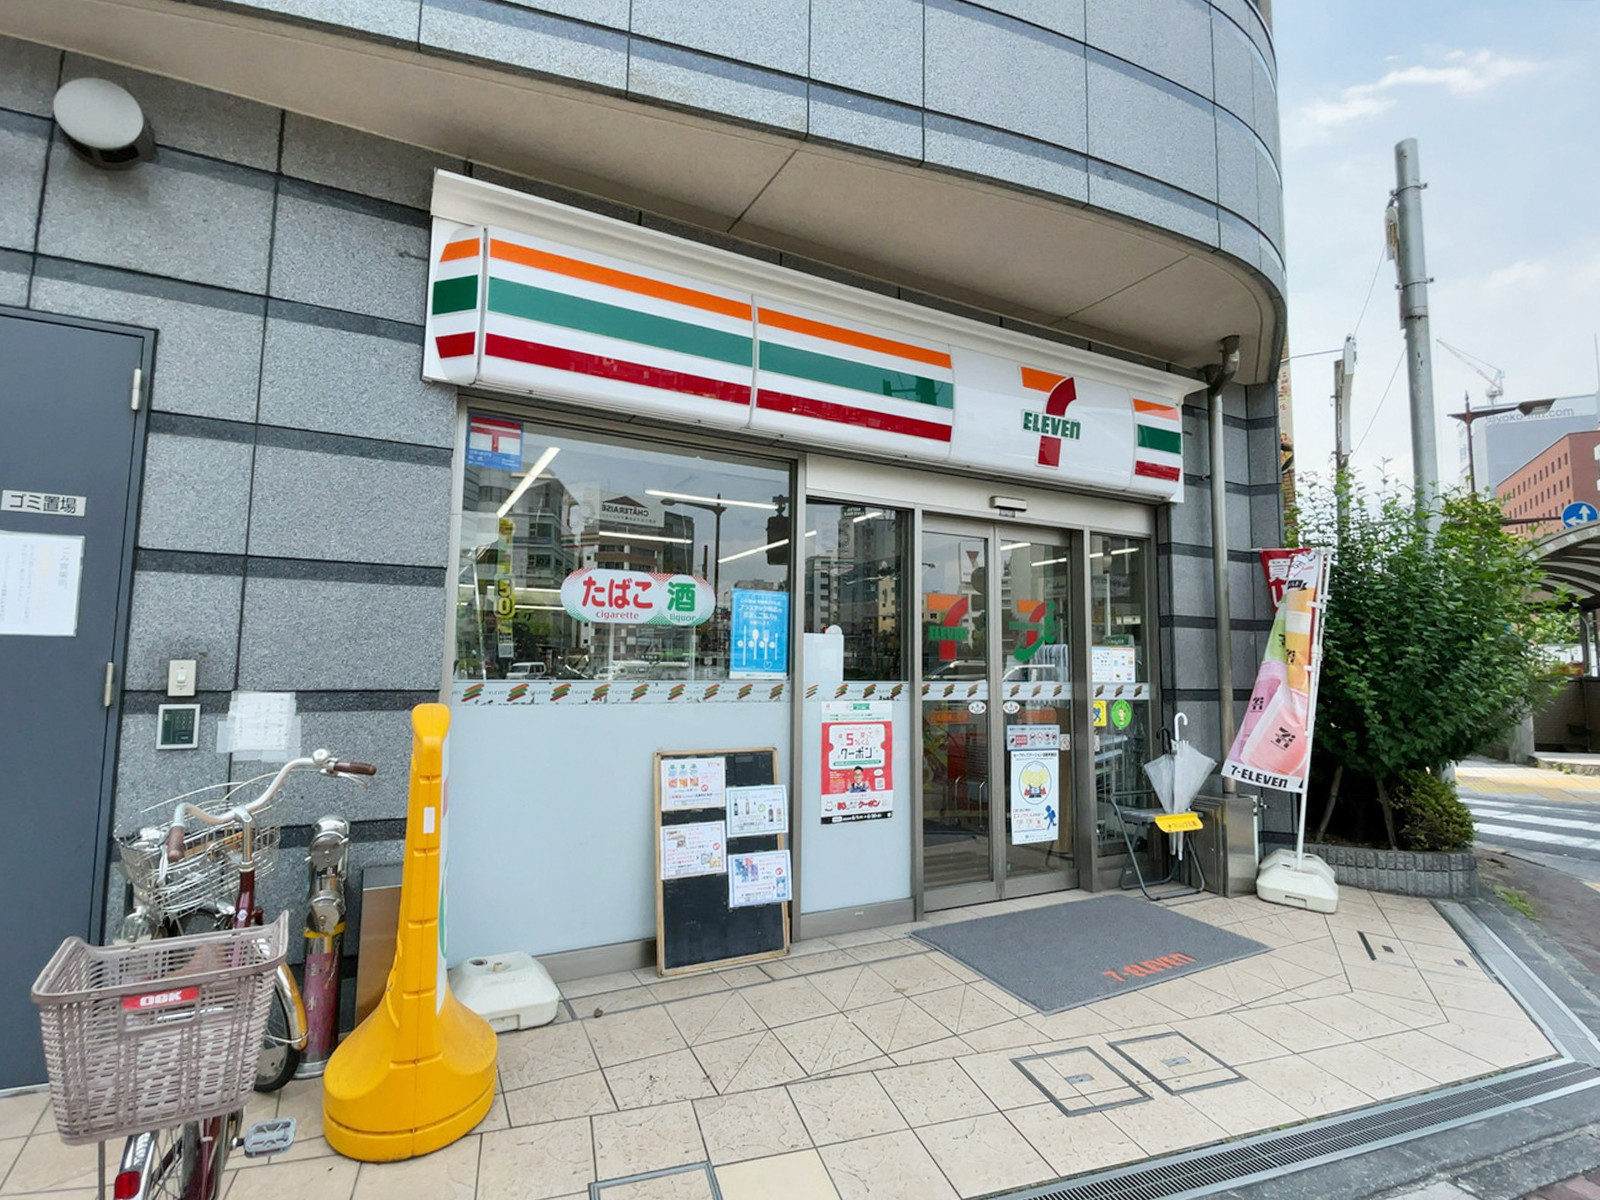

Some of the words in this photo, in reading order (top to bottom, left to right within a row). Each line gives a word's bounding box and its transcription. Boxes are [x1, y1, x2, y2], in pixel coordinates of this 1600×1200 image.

[1021, 366, 1077, 467] 7
[9, 493, 77, 514] ゴミ置場
[582, 576, 653, 609] たばこ
[667, 581, 696, 612] 酒
[595, 610, 639, 620] cigarette
[669, 613, 696, 622] liquor
